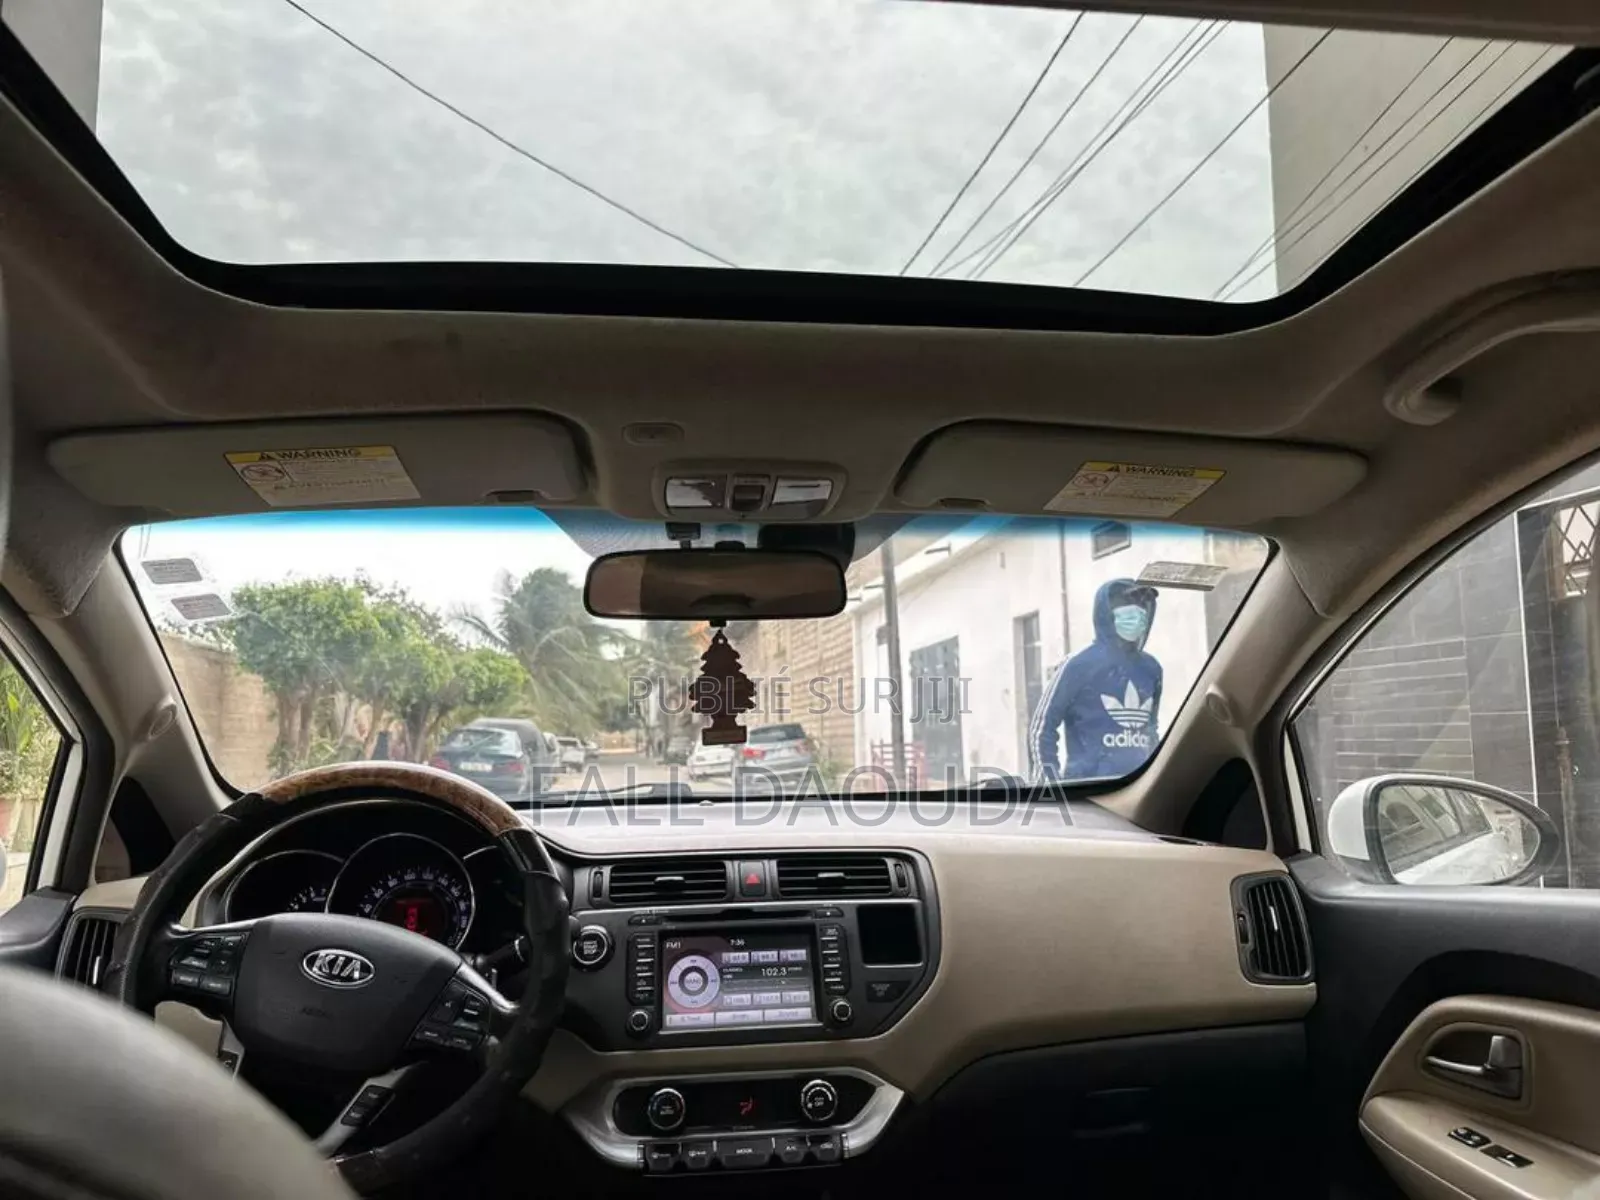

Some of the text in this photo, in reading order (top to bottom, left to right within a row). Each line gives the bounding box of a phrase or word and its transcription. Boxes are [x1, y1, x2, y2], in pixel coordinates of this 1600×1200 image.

[276, 448, 362, 461] WARNING
[1125, 464, 1196, 478] WARNING
[1102, 729, 1150, 749] adida
[666, 941, 681, 949] FM1
[312, 952, 361, 980] KIA
[761, 966, 787, 977] 102.3
